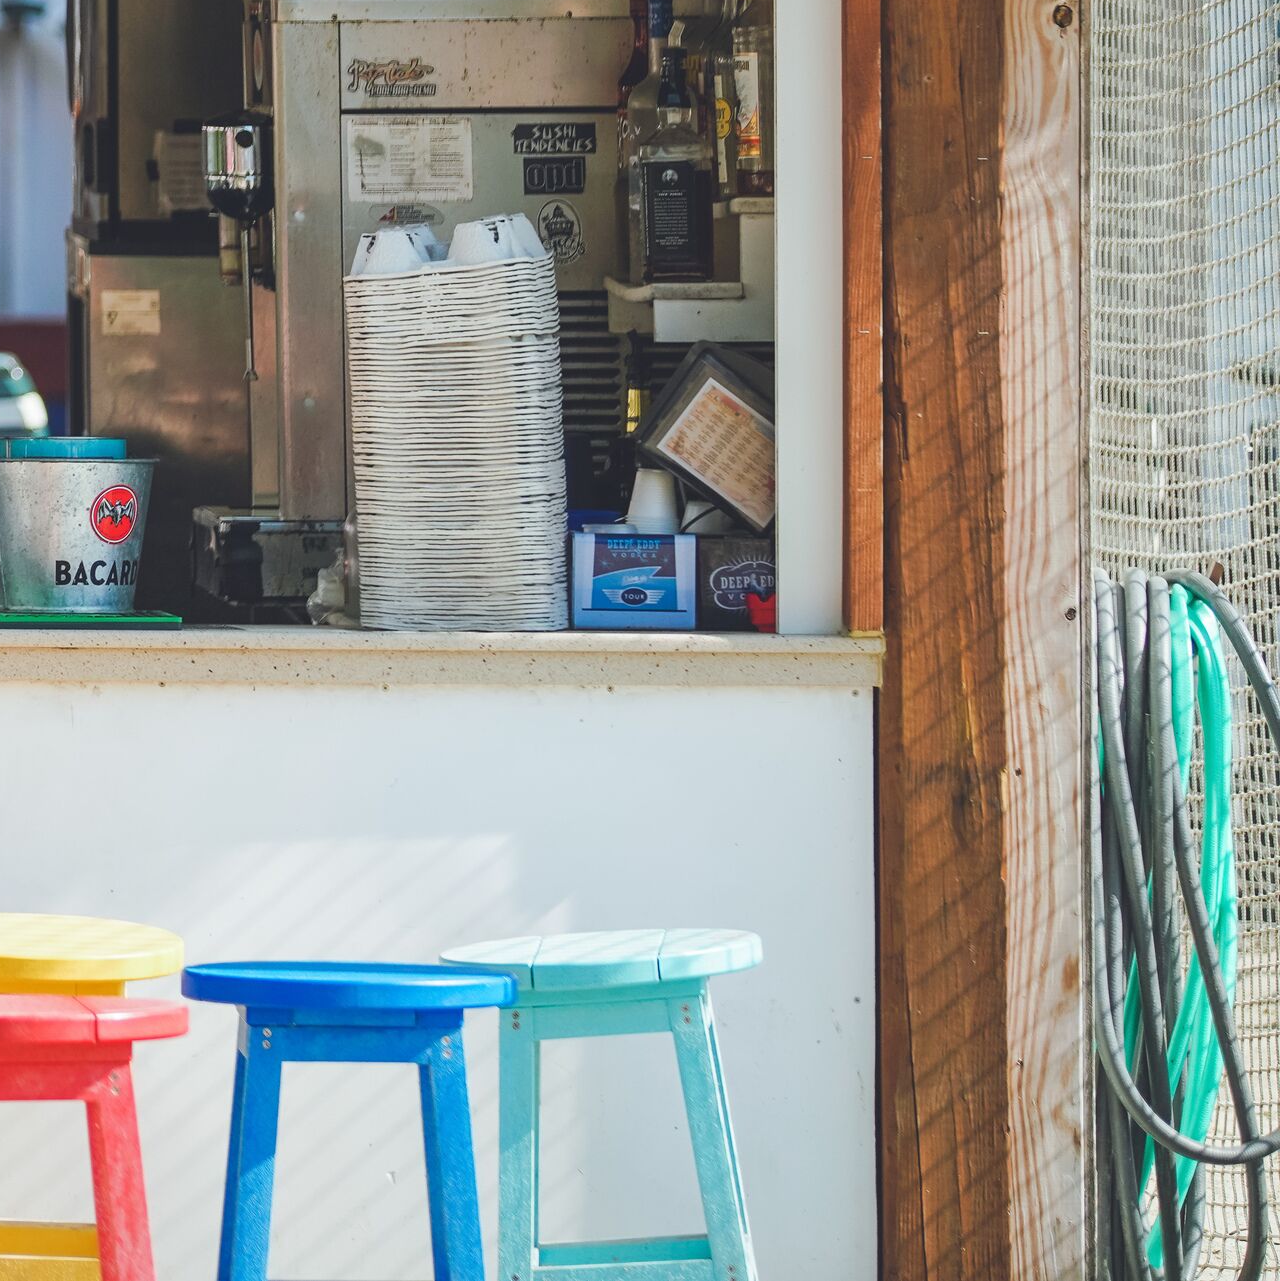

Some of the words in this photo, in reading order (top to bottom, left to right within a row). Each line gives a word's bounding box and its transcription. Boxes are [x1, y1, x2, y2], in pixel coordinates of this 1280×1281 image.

[531, 124, 576, 139] SUSHI
[515, 137, 593, 152] TENDENCIES
[638, 538, 661, 550] EDDY
[55, 559, 138, 586] BACARD
[720, 576, 750, 589] DEEP
[760, 575, 775, 588] ED
